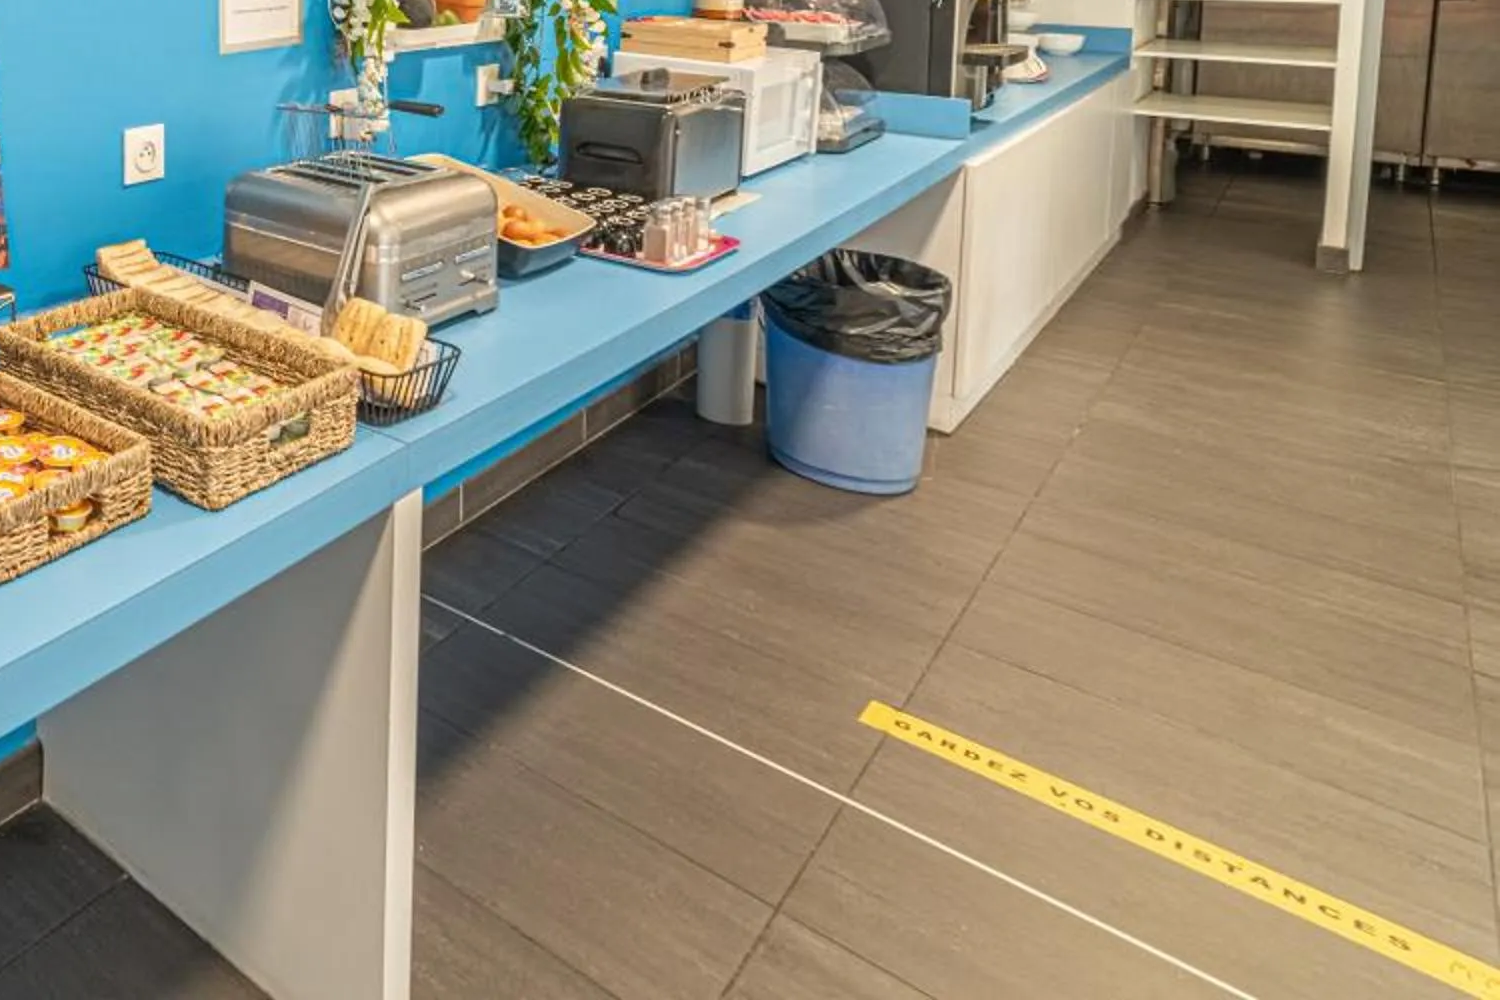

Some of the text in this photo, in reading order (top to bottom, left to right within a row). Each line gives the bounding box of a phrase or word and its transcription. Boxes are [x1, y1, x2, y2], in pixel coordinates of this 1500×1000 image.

[894, 719, 1412, 951] GARDEZ VOS DISTANCES
